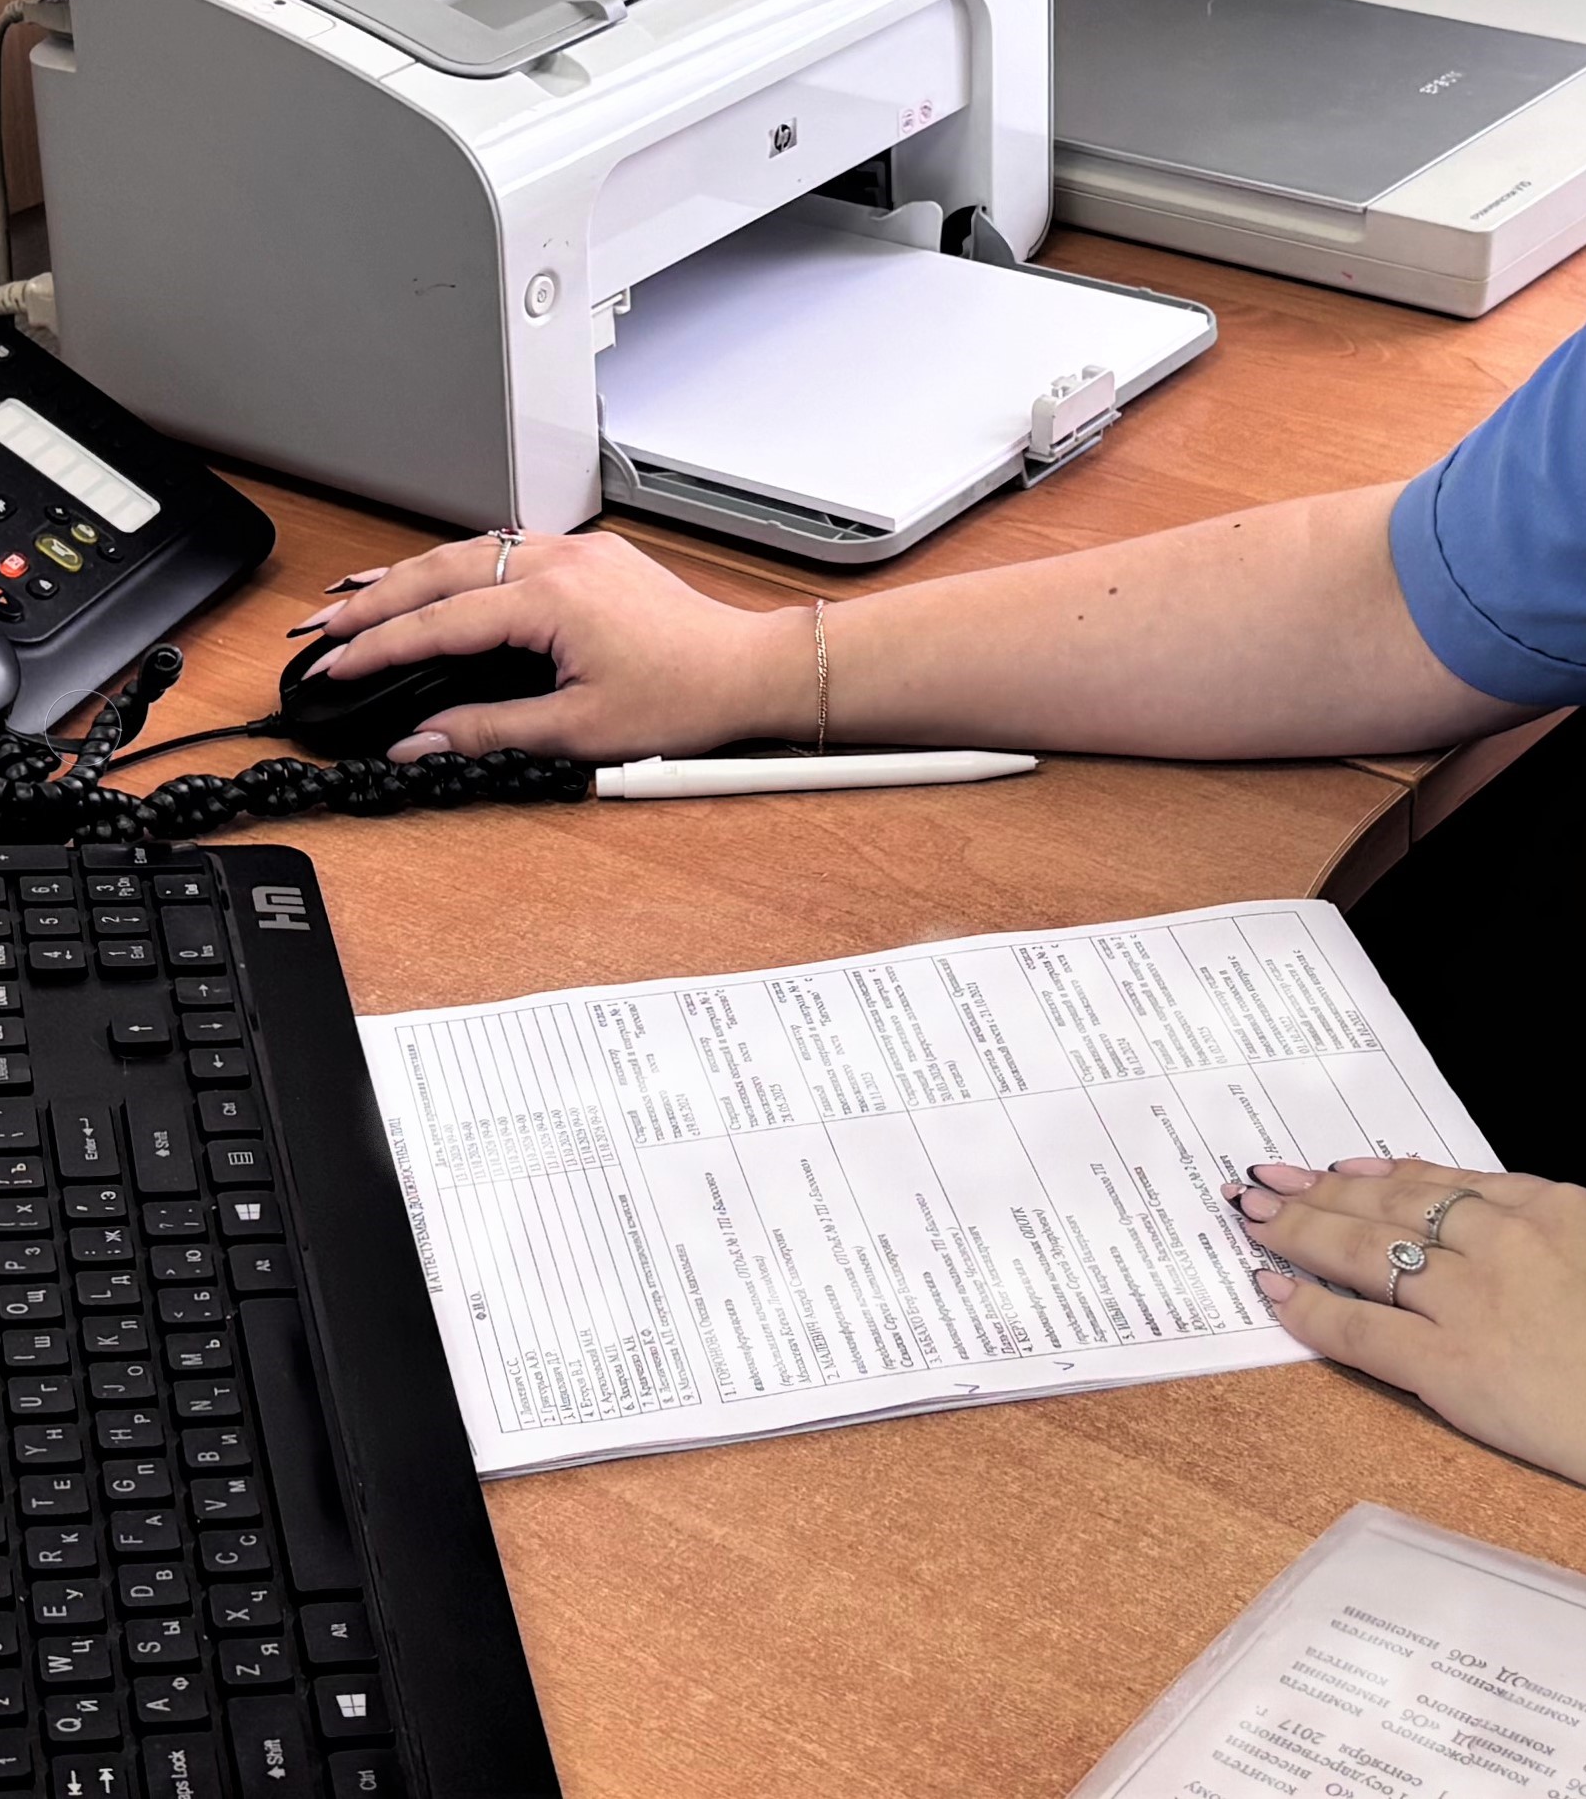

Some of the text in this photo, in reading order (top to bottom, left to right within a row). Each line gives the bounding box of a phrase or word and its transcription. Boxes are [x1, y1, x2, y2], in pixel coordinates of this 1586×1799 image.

[1331, 1618, 1414, 1658] комитета
[1343, 1605, 1440, 1650] изменении
[1292, 1660, 1391, 1709] изменении
[1305, 1645, 1389, 1687] комитета
[1279, 1674, 1364, 1718] комитета
[1212, 1749, 1298, 1798] комитета
[1224, 1734, 1312, 1780] внесении
[1278, 1718, 1423, 1788] сентября 2017
